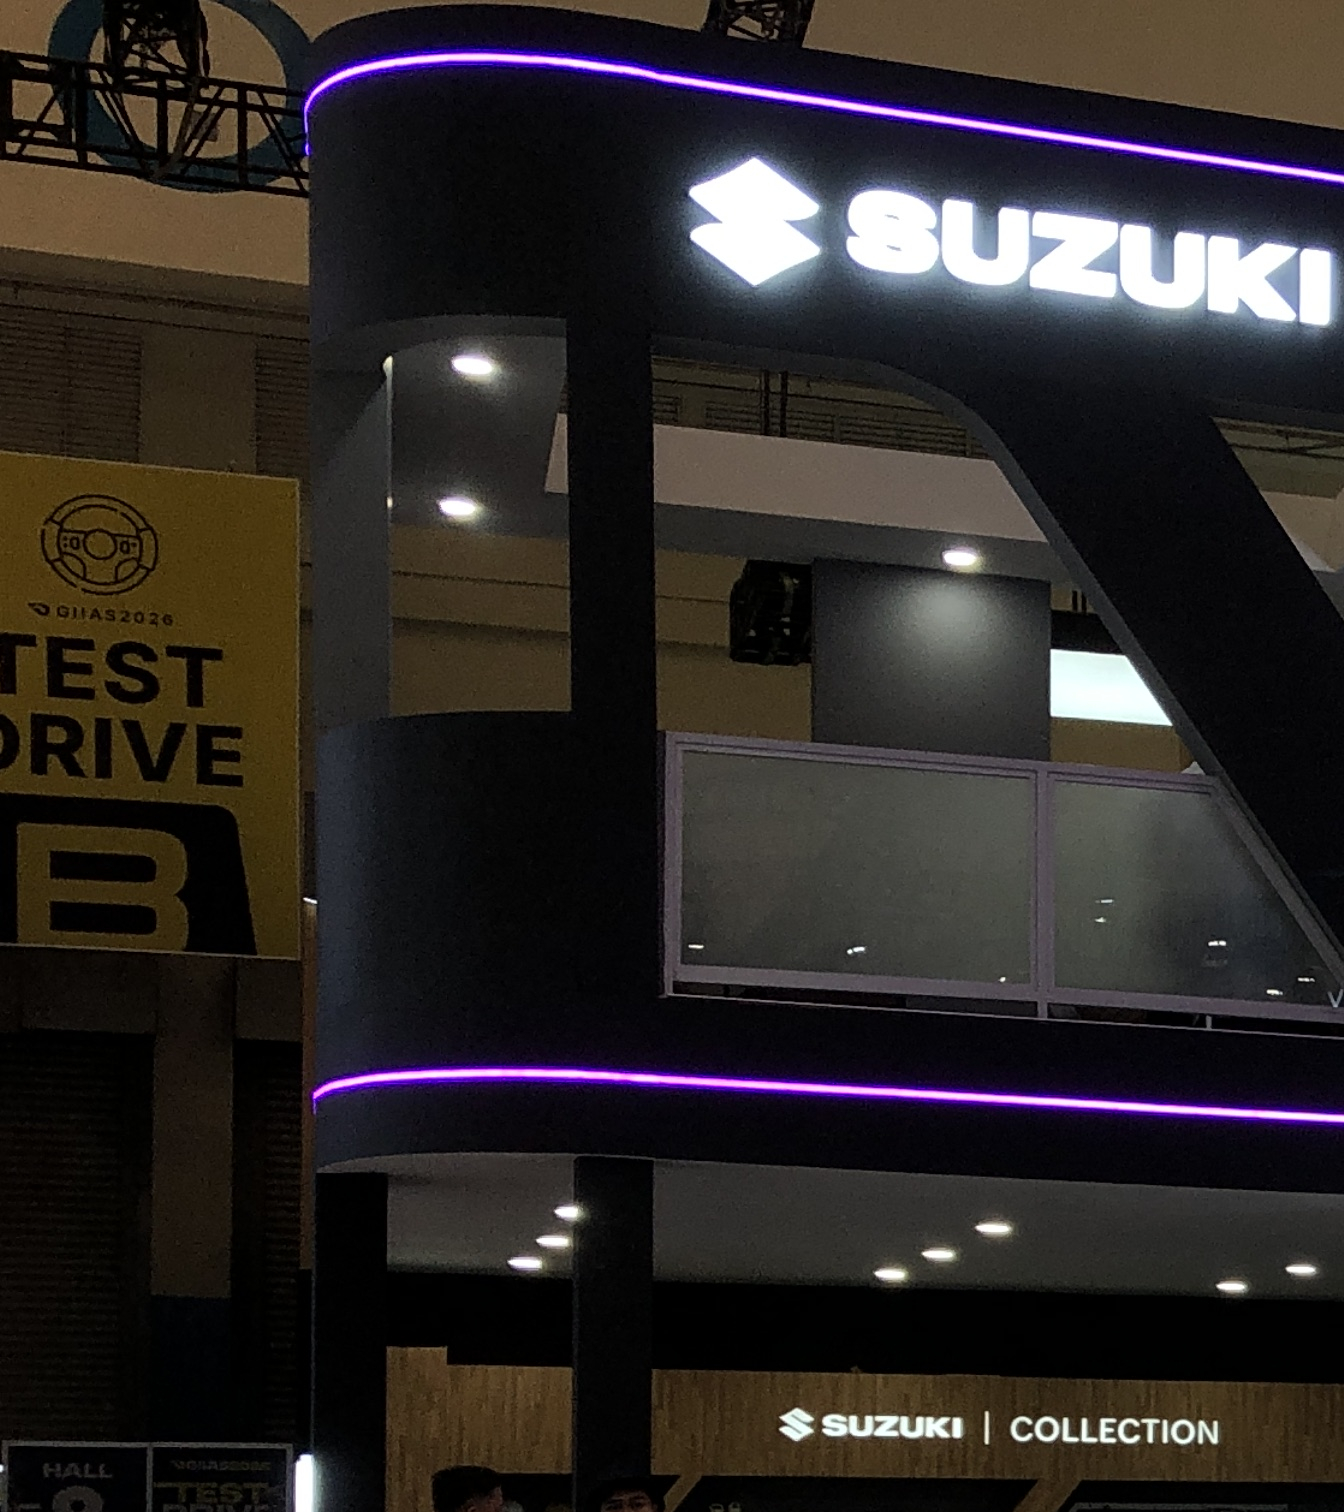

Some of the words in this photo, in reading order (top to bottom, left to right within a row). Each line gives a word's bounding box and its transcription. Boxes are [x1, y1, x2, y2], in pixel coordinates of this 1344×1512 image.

[845, 189, 1333, 327] SUZUKI
[56, 604, 174, 626] GIIAS2026
[0, 631, 223, 708] TEST
[16, 822, 189, 950] B
[821, 1413, 965, 1440] SUZUKI
[1009, 1415, 1220, 1446] COLLECTION
[43, 1462, 113, 1479] HALL
[153, 1481, 268, 1504] TEST
